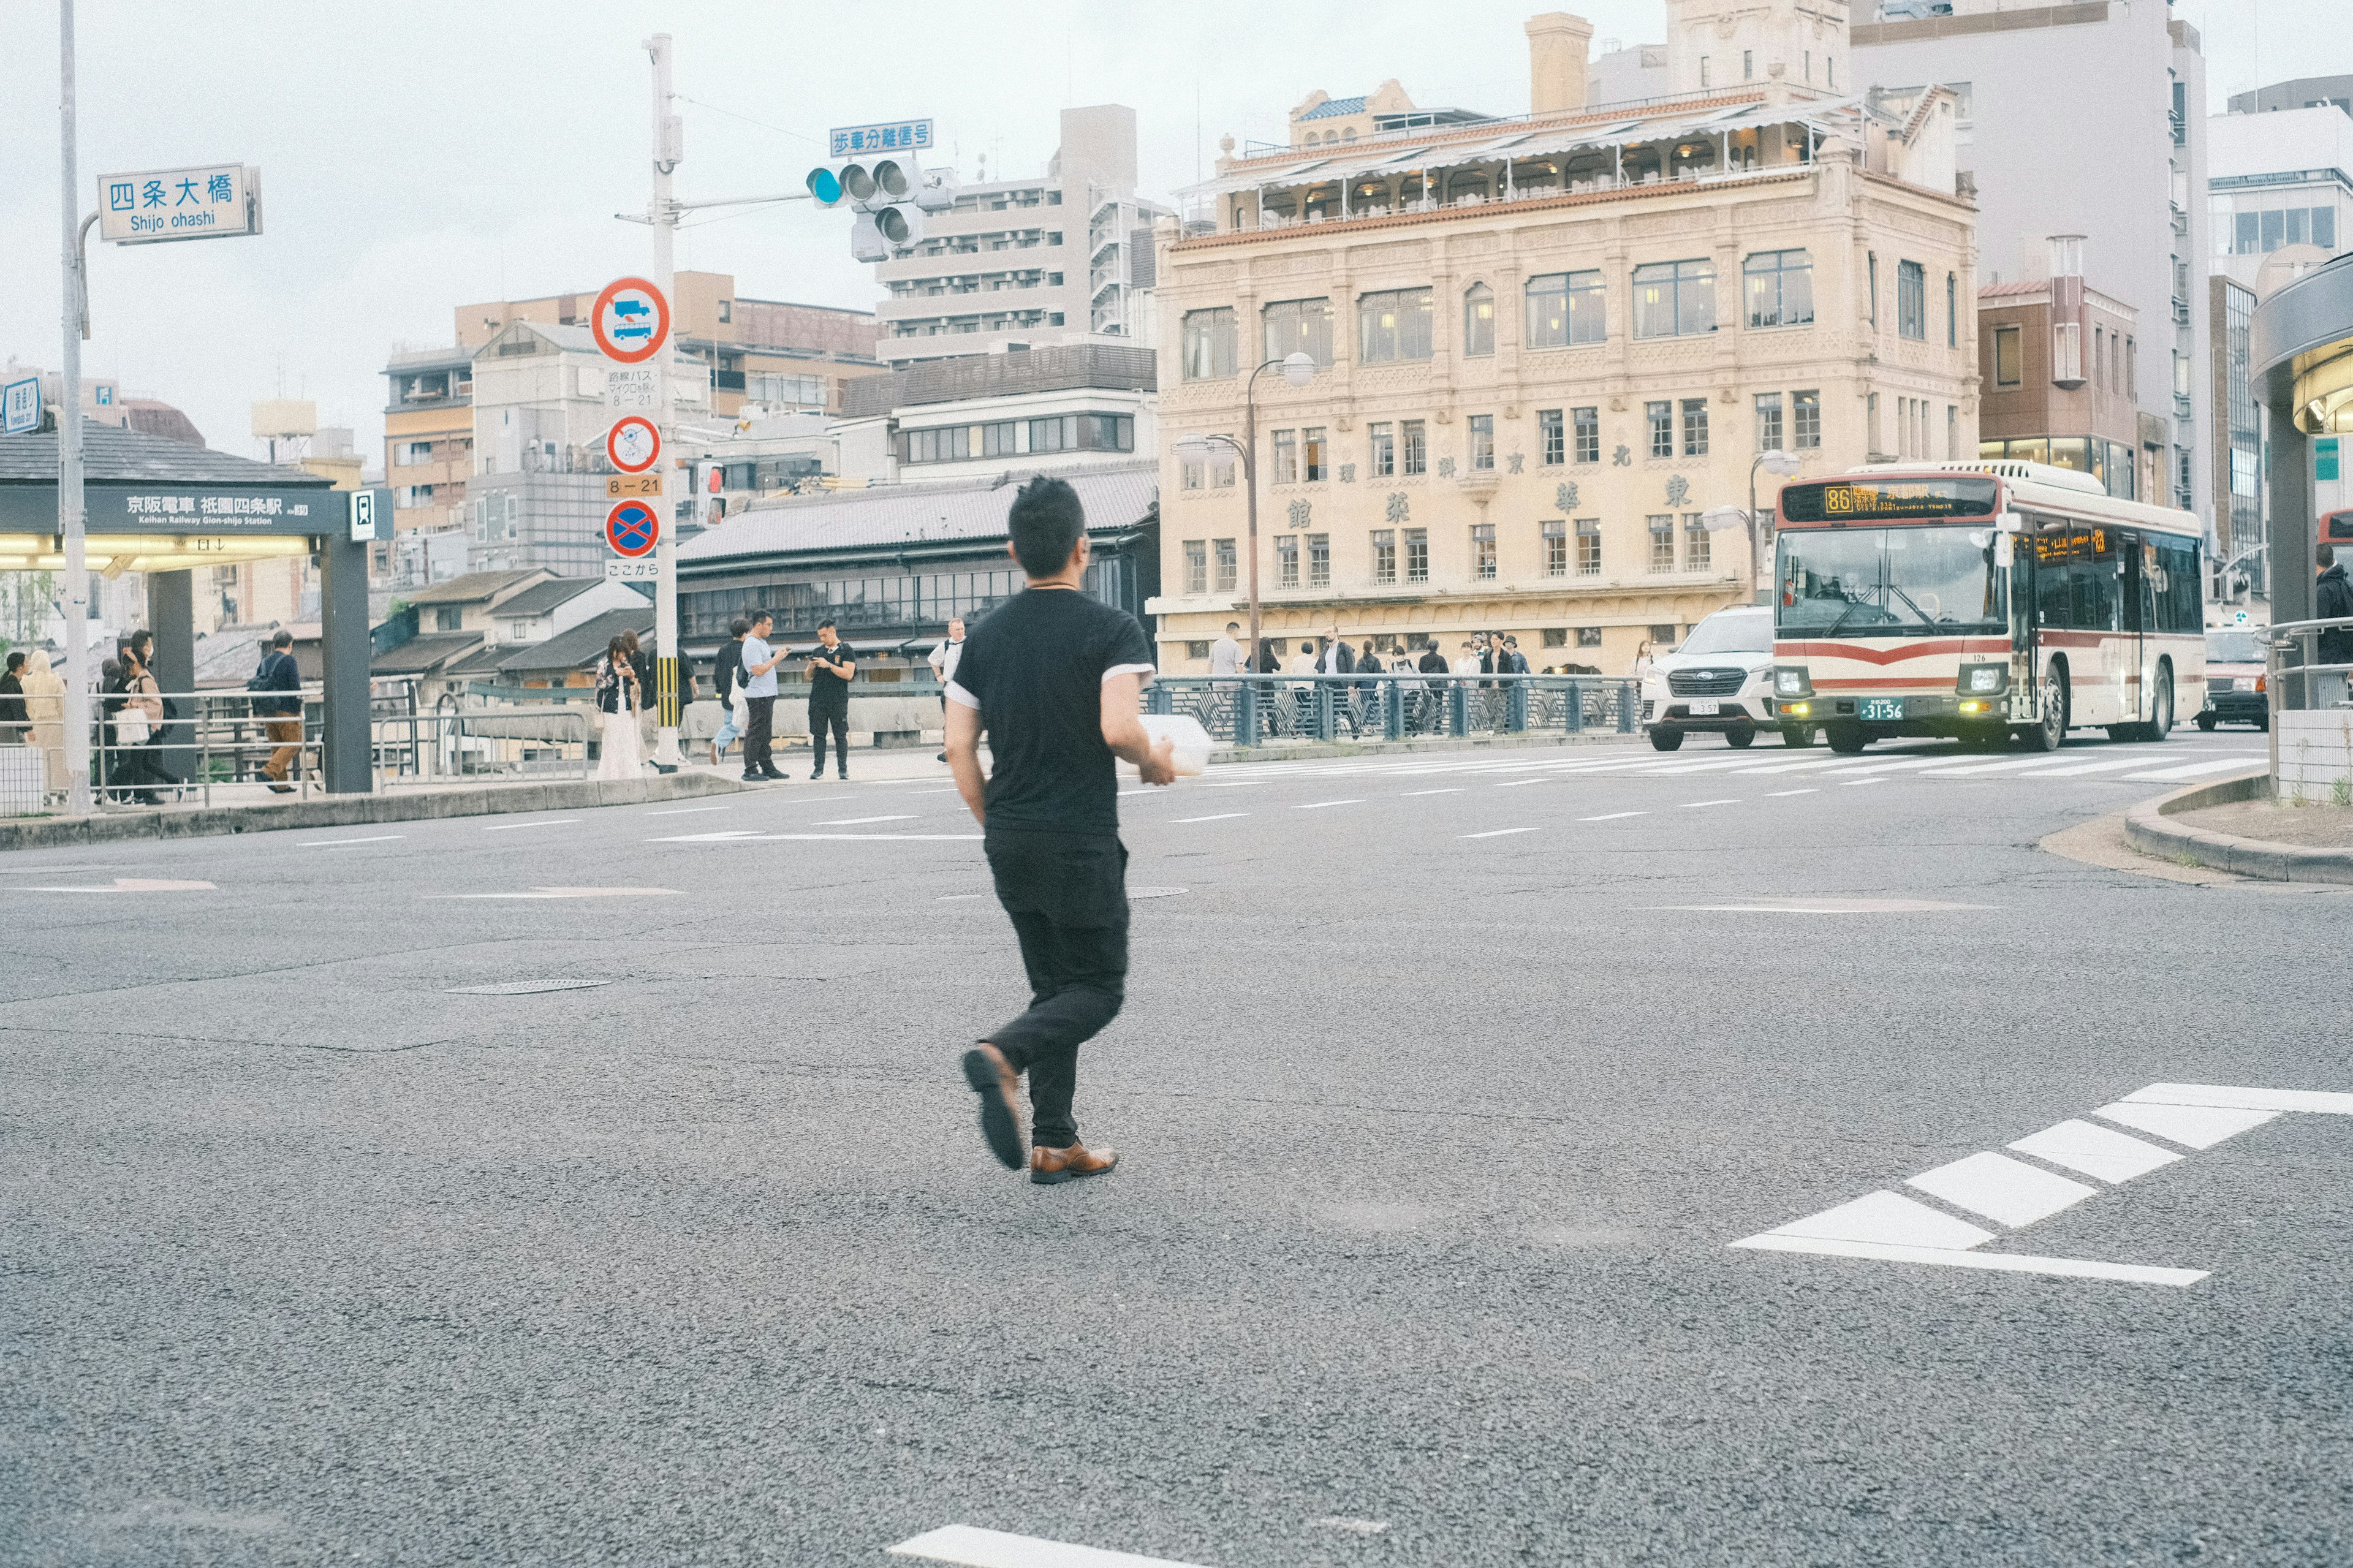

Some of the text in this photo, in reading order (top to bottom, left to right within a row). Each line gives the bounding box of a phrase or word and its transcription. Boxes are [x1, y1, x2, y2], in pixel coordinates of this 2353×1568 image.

[834, 124, 928, 153] 歩車分離信号
[110, 173, 232, 211] 四条大橋
[131, 210, 214, 232] Shijo ohashi
[127, 496, 282, 515] 京阪電車 祇園四条駅
[1828, 490, 1850, 510] 86
[169, 516, 201, 526] Railway
[202, 516, 243, 526] Gion-shijo
[244, 517, 272, 525] Station
[609, 564, 659, 576] ここから
